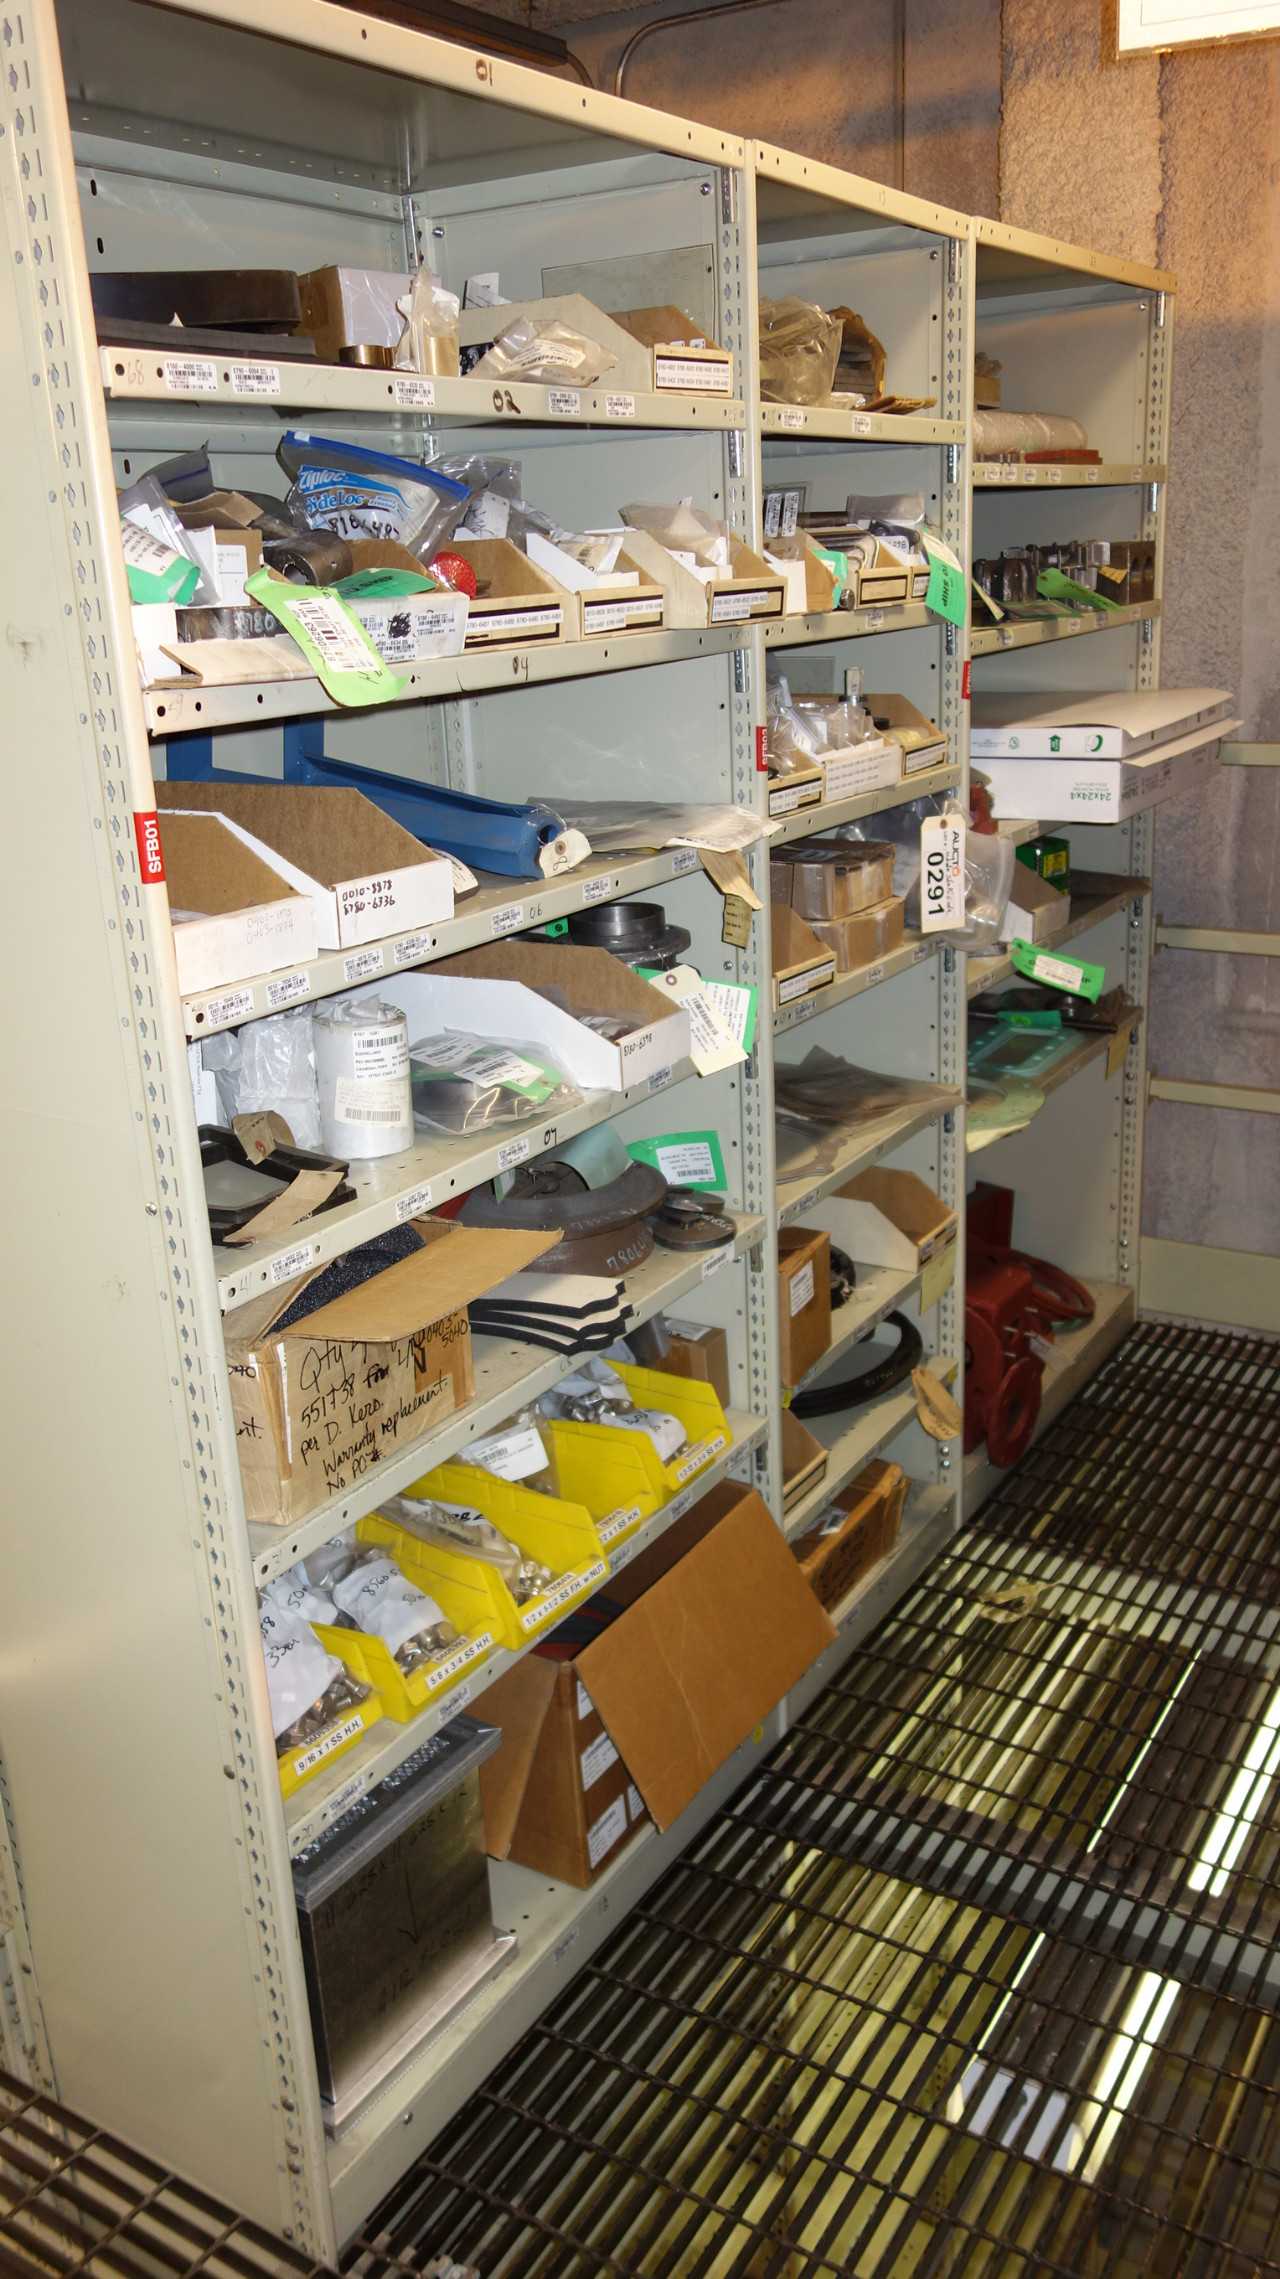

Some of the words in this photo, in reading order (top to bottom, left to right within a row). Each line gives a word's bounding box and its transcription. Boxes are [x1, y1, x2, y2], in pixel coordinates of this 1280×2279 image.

[143, 819, 162, 874] SFB01
[927, 852, 945, 915] 0291
[323, 1422, 377, 1477] Warranty
[559, 1589, 570, 1600] SS
[589, 1562, 605, 1577] NUT
[464, 1647, 475, 1660] SS
[298, 1752, 317, 1772] 9/16
[331, 1732, 343, 1746] SS
